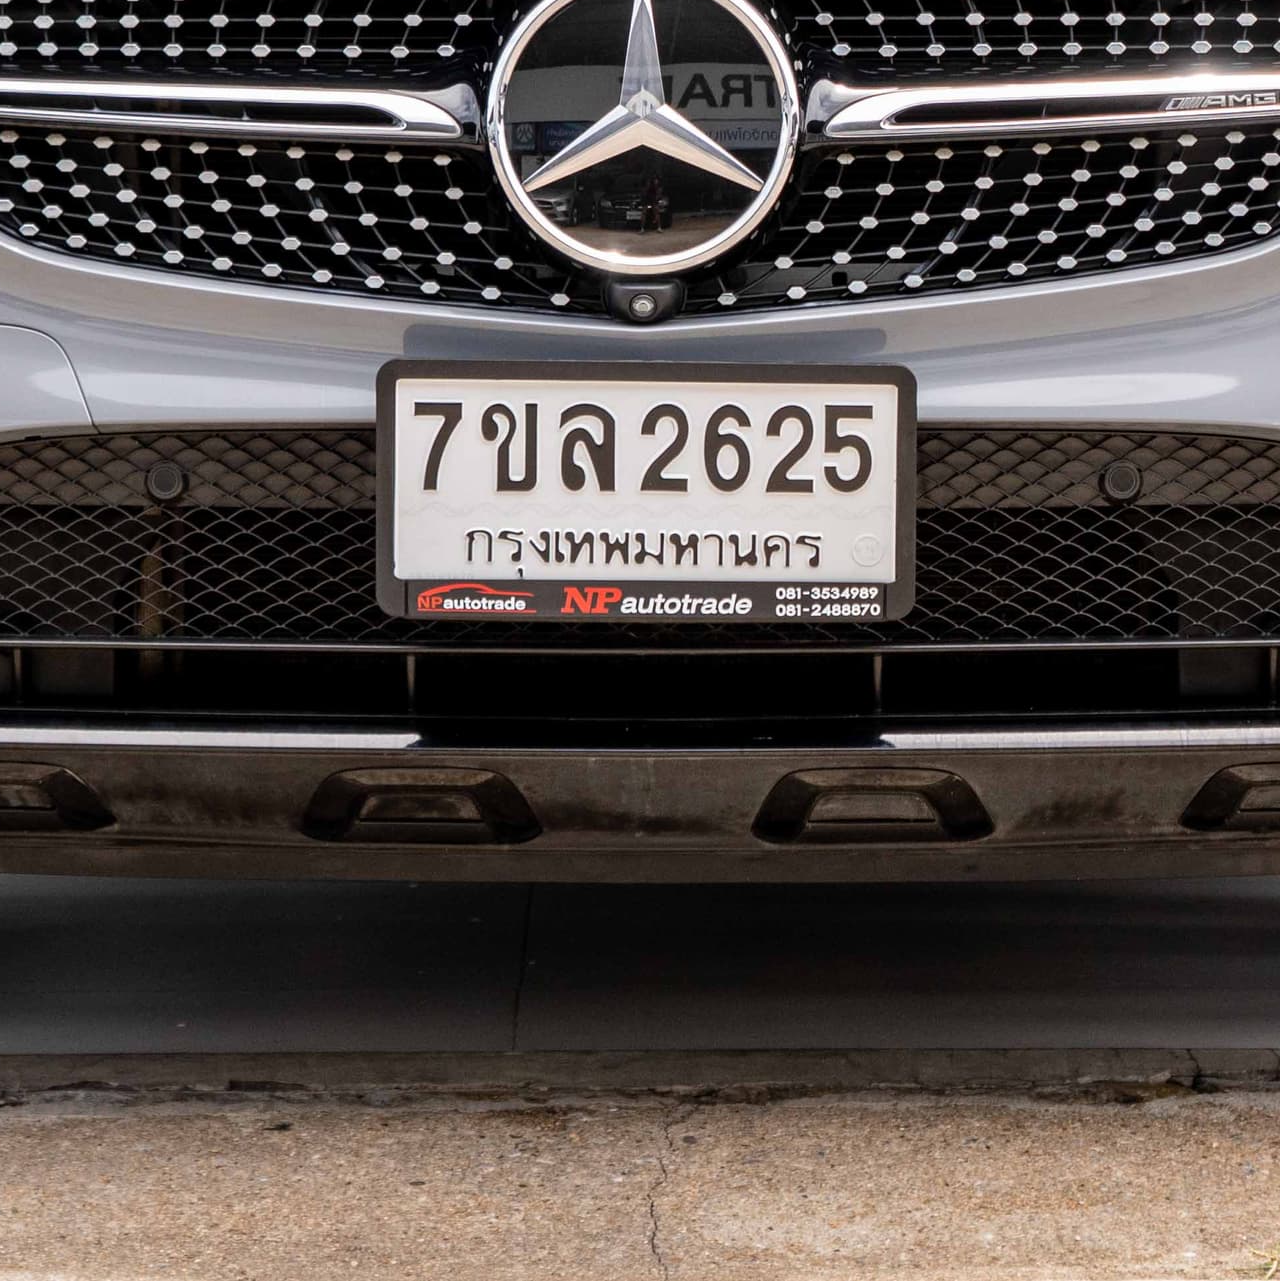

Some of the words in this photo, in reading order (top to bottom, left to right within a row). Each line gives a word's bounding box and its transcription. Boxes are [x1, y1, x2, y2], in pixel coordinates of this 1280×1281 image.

[639, 403, 874, 494] 2625
[465, 528, 823, 577] กรุงเทพมหานคร
[775, 587, 879, 600] 081-3534989
[775, 604, 881, 617] 081-2488870
